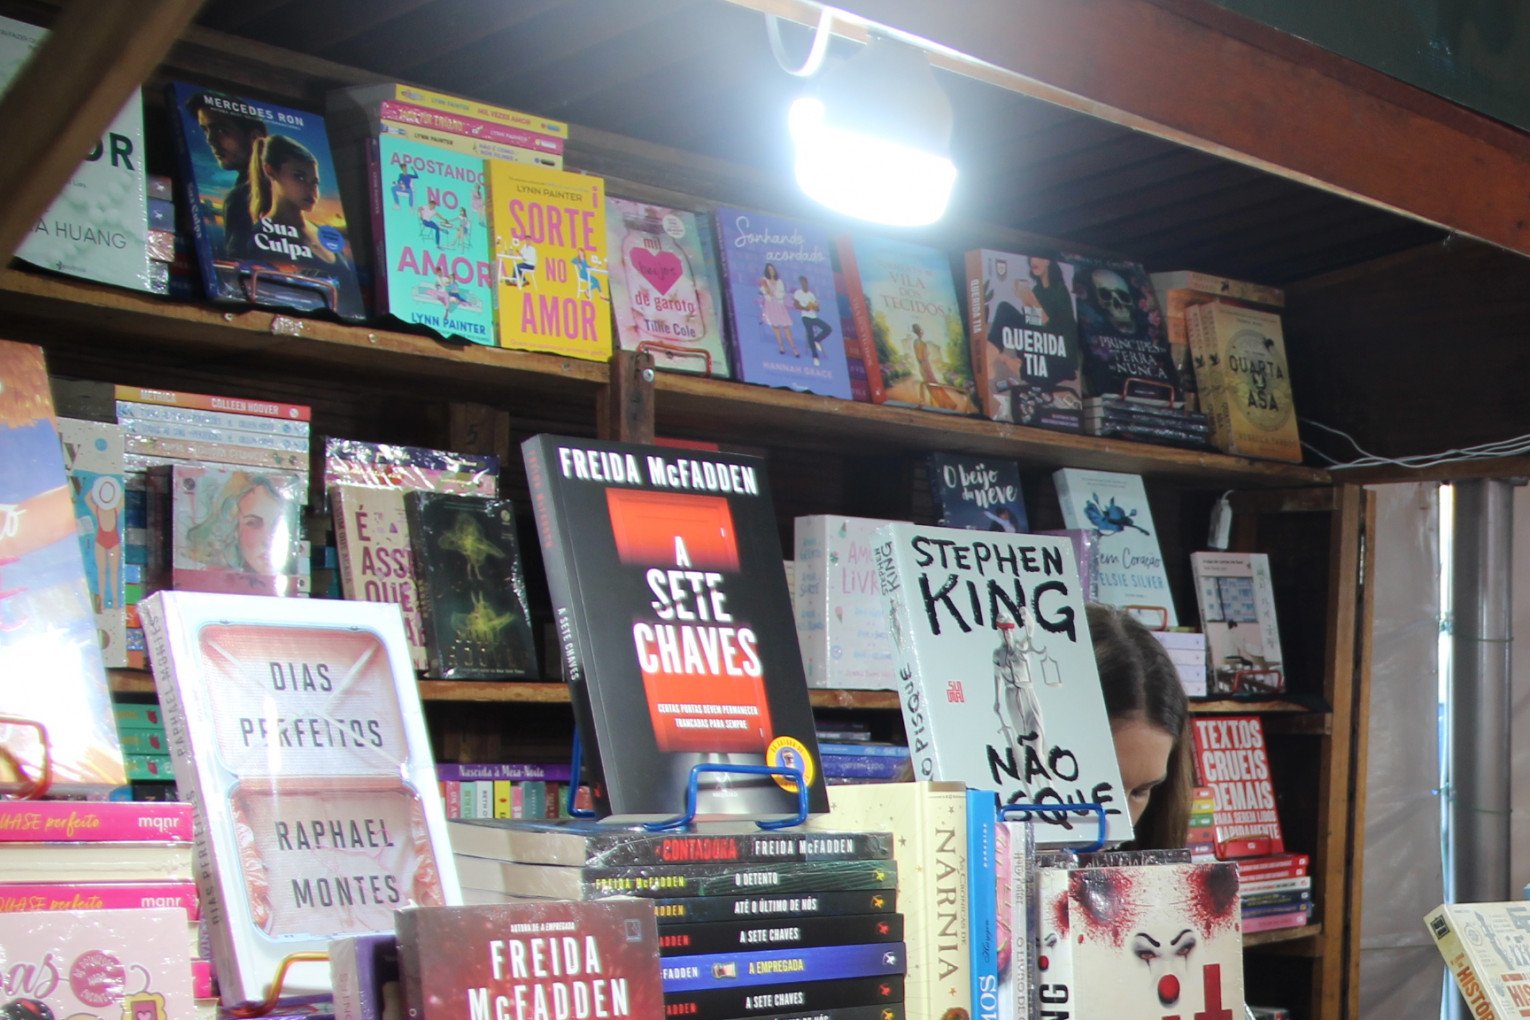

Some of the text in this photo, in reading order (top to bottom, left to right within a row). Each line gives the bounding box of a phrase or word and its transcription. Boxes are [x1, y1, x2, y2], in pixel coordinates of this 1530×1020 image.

[203, 94, 274, 121] MERCEDES
[277, 112, 305, 128] RON
[427, 187, 459, 210] NO
[517, 184, 583, 202] LYNN PAINTER
[56, 219, 127, 250] HUANG
[262, 217, 299, 239] Sua
[508, 198, 597, 252] SORTE
[254, 234, 314, 261] Culpa
[642, 237, 661, 251] mil
[397, 246, 492, 289] AMOR
[545, 257, 567, 283] NO
[521, 291, 598, 342] AMOR
[635, 290, 696, 315] de garoto
[411, 311, 486, 335] LYNN PAINTER
[645, 318, 697, 338] Tillie Cole
[1002, 325, 1067, 359] QUERIDA
[1024, 352, 1049, 379] TIA
[1228, 354, 1285, 380] QUARTA
[211, 396, 280, 416] COLLEEN HOOVER
[1247, 393, 1279, 412] ASA
[558, 447, 758, 496] FREIDA McFADDEN
[942, 462, 1001, 490] O beijo
[674, 535, 691, 567] A
[911, 535, 1064, 577] STEPHEN
[646, 568, 733, 622] SETE
[1098, 572, 1166, 591] ELSIE SILVER
[918, 572, 1077, 643] KING
[632, 621, 764, 677] CHAVES
[268, 661, 334, 693] DIAS
[240, 718, 385, 749] PERFEITOS
[1196, 718, 1263, 750] TEXTOS
[986, 731, 1080, 786] NÃO
[1213, 781, 1275, 812] DEMAIS
[138, 816, 180, 832] mqnr
[275, 817, 394, 853] RAPHAEL
[755, 838, 854, 855] FREIDA McFADDEN
[293, 872, 401, 909] MONTES
[743, 871, 779, 886] DETENTO
[935, 827, 961, 982] NÁRNIA
[770, 927, 800, 941] CHAVES
[490, 935, 601, 981] FREIDA
[756, 958, 804, 974] EMPREGADA
[774, 992, 804, 1007] CHAVES
